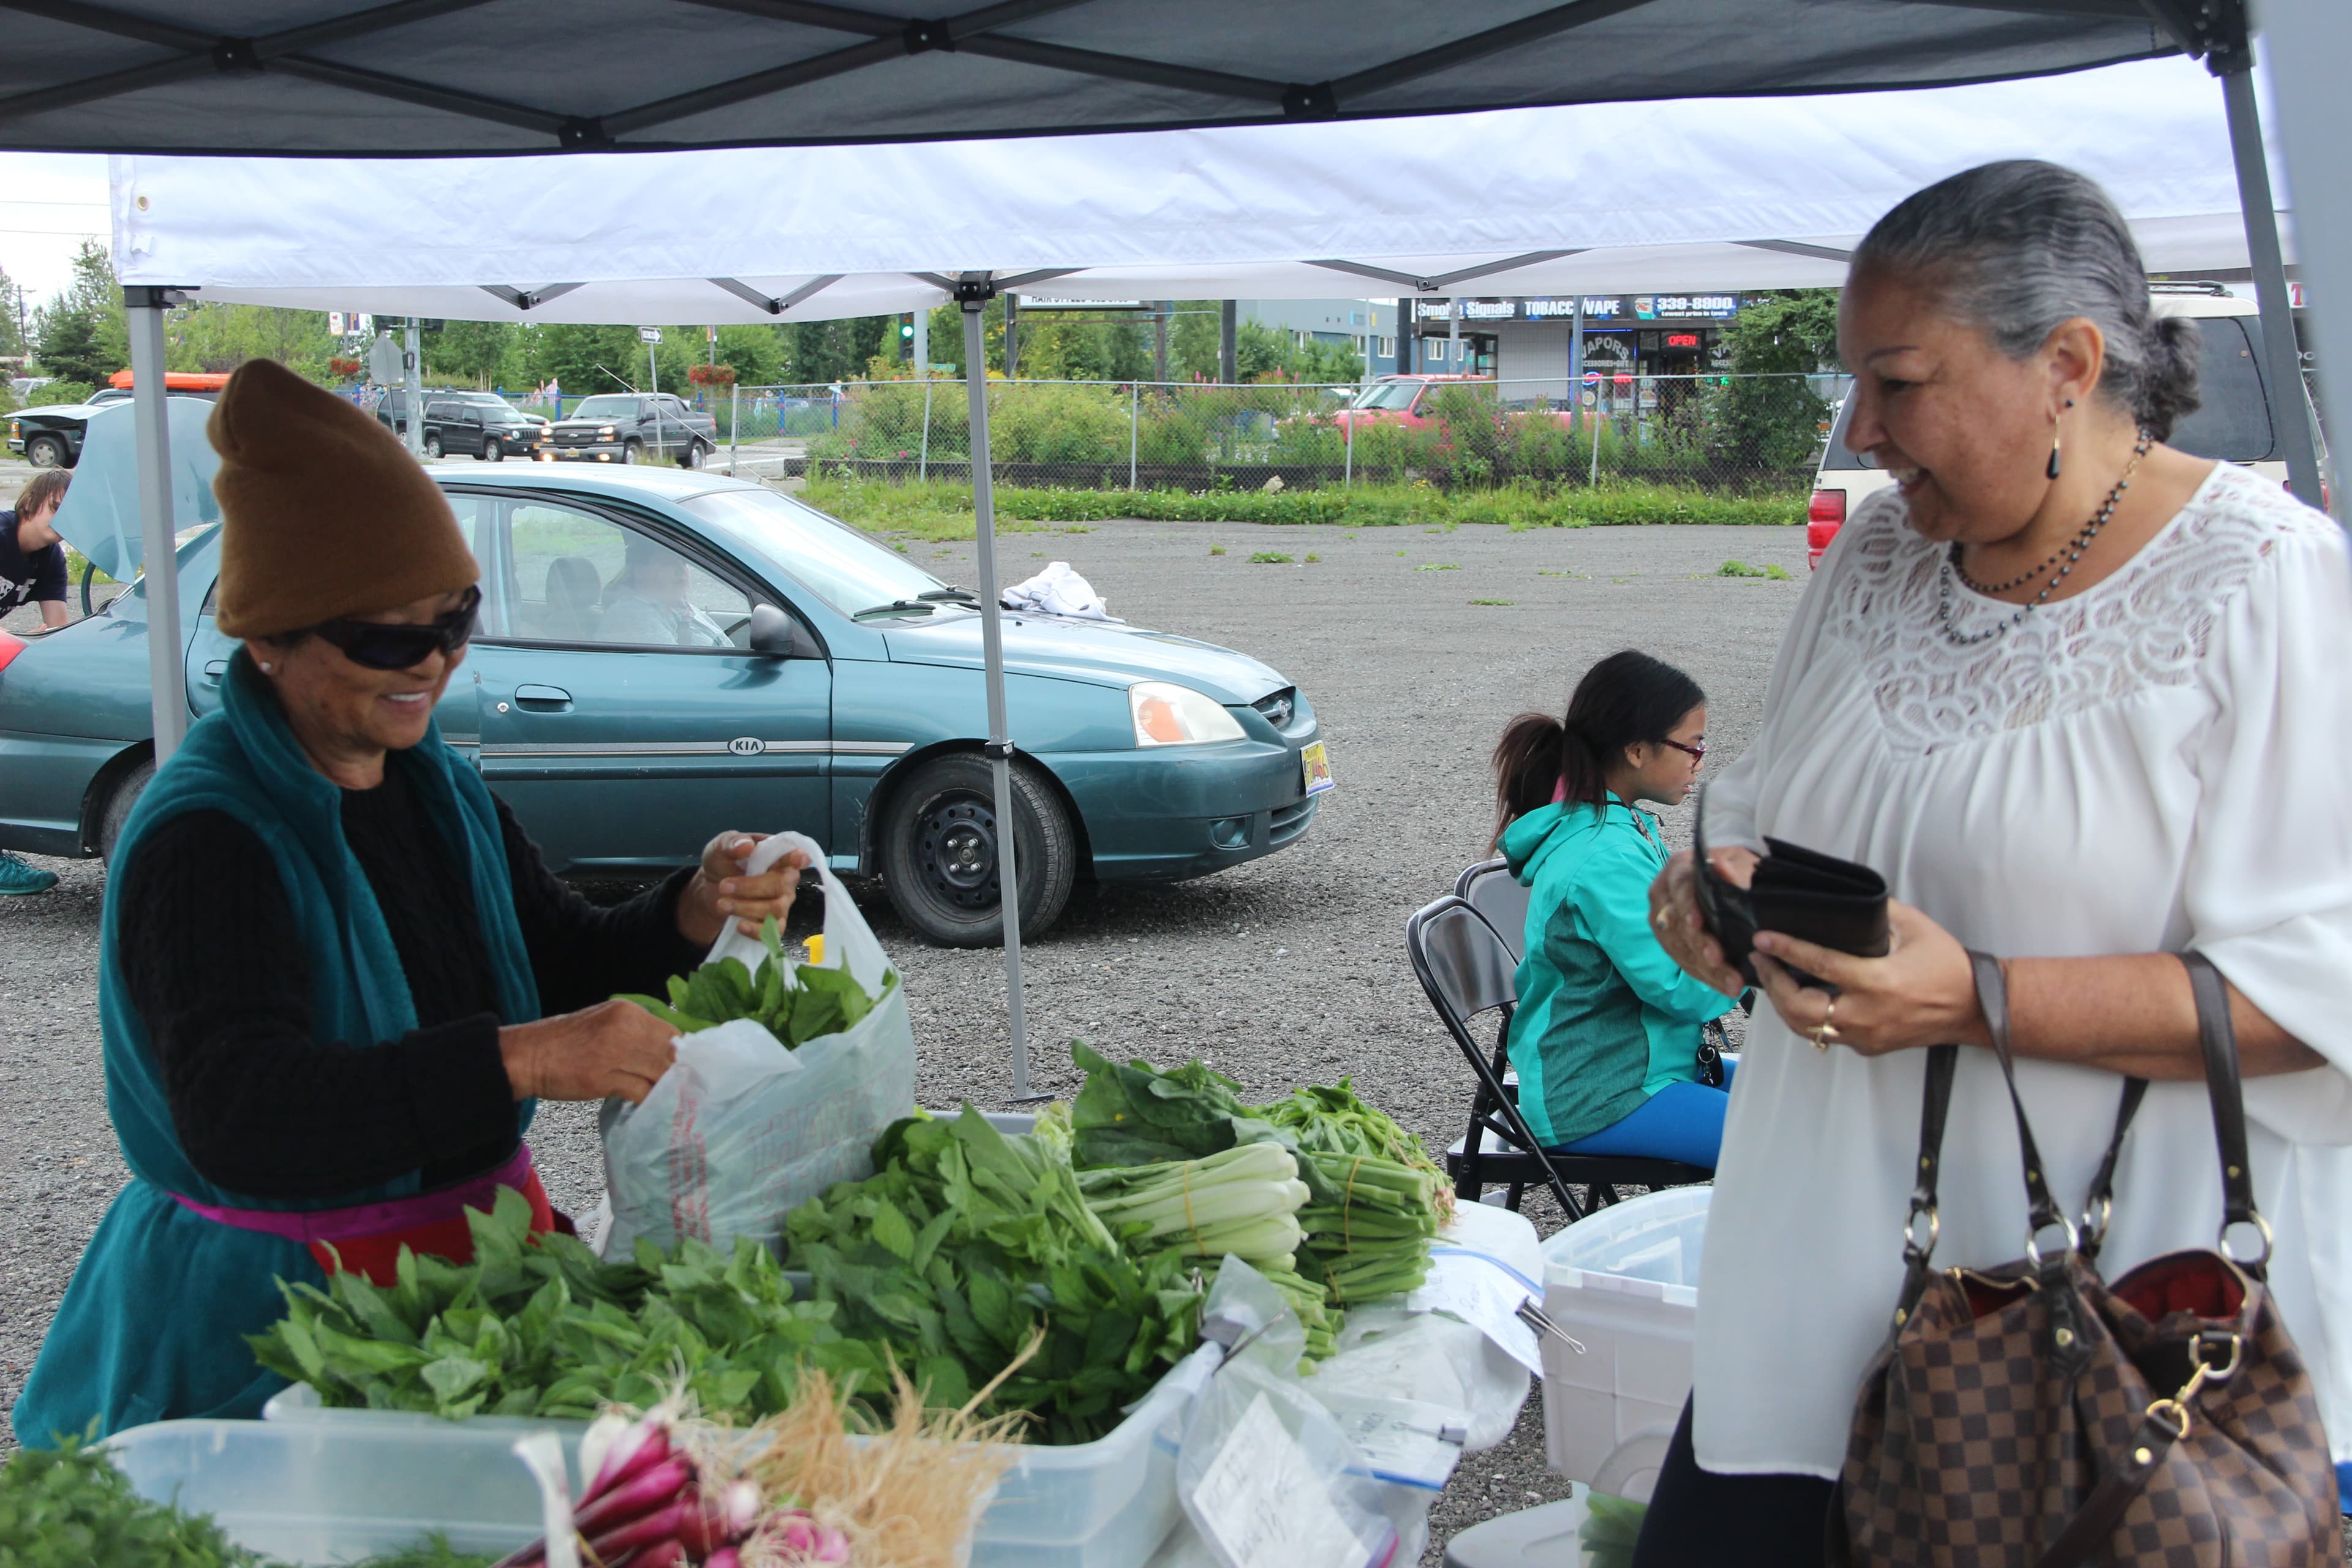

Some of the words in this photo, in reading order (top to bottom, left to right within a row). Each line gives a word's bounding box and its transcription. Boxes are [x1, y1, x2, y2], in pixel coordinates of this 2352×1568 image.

[1466, 301, 1515, 316] Signals
[1525, 298, 1620, 315] TOBACC/VAPE
[1582, 336, 1629, 360] VAPORS
[1668, 335, 1697, 347] OPEN
[736, 741, 760, 750] KIA
